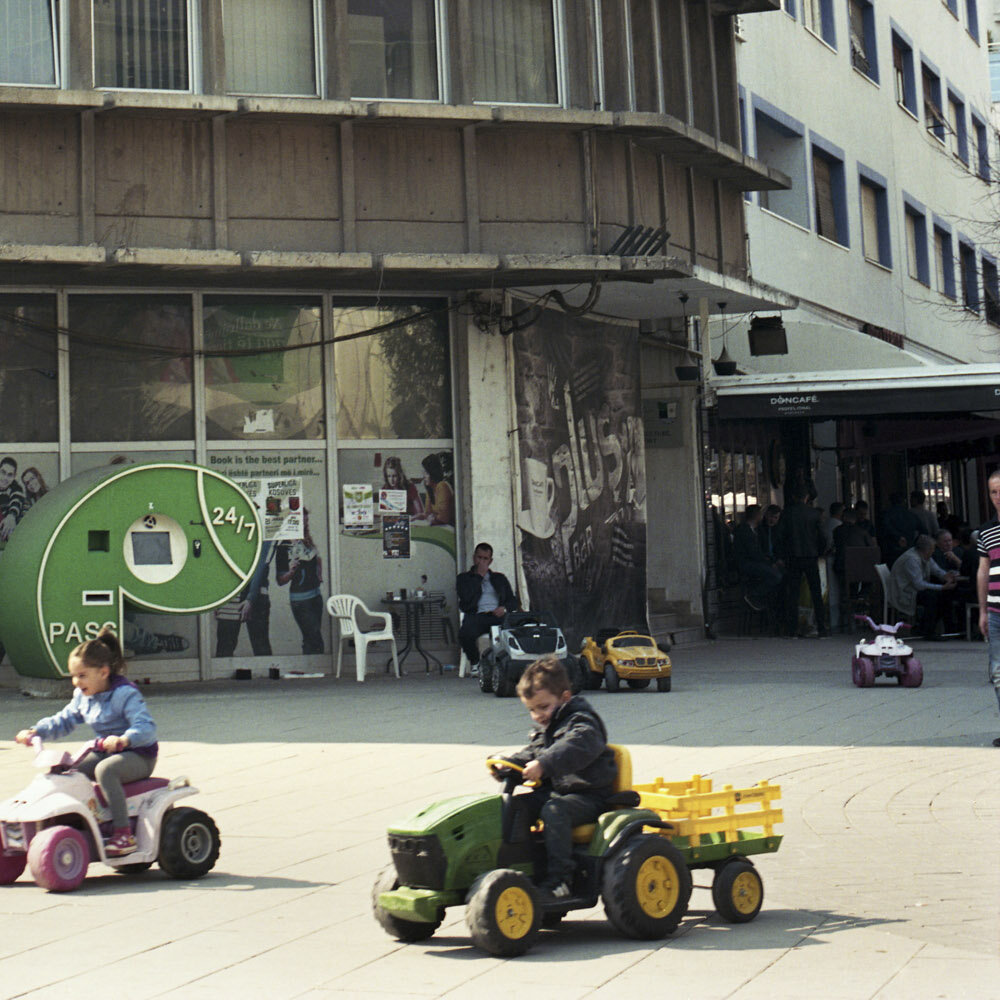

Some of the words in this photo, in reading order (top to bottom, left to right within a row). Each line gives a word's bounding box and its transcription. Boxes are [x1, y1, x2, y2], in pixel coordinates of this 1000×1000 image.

[210, 456, 233, 464] Book
[235, 456, 243, 464] is
[245, 456, 260, 464] the
[262, 456, 281, 464] best
[212, 506, 256, 541] 24/7
